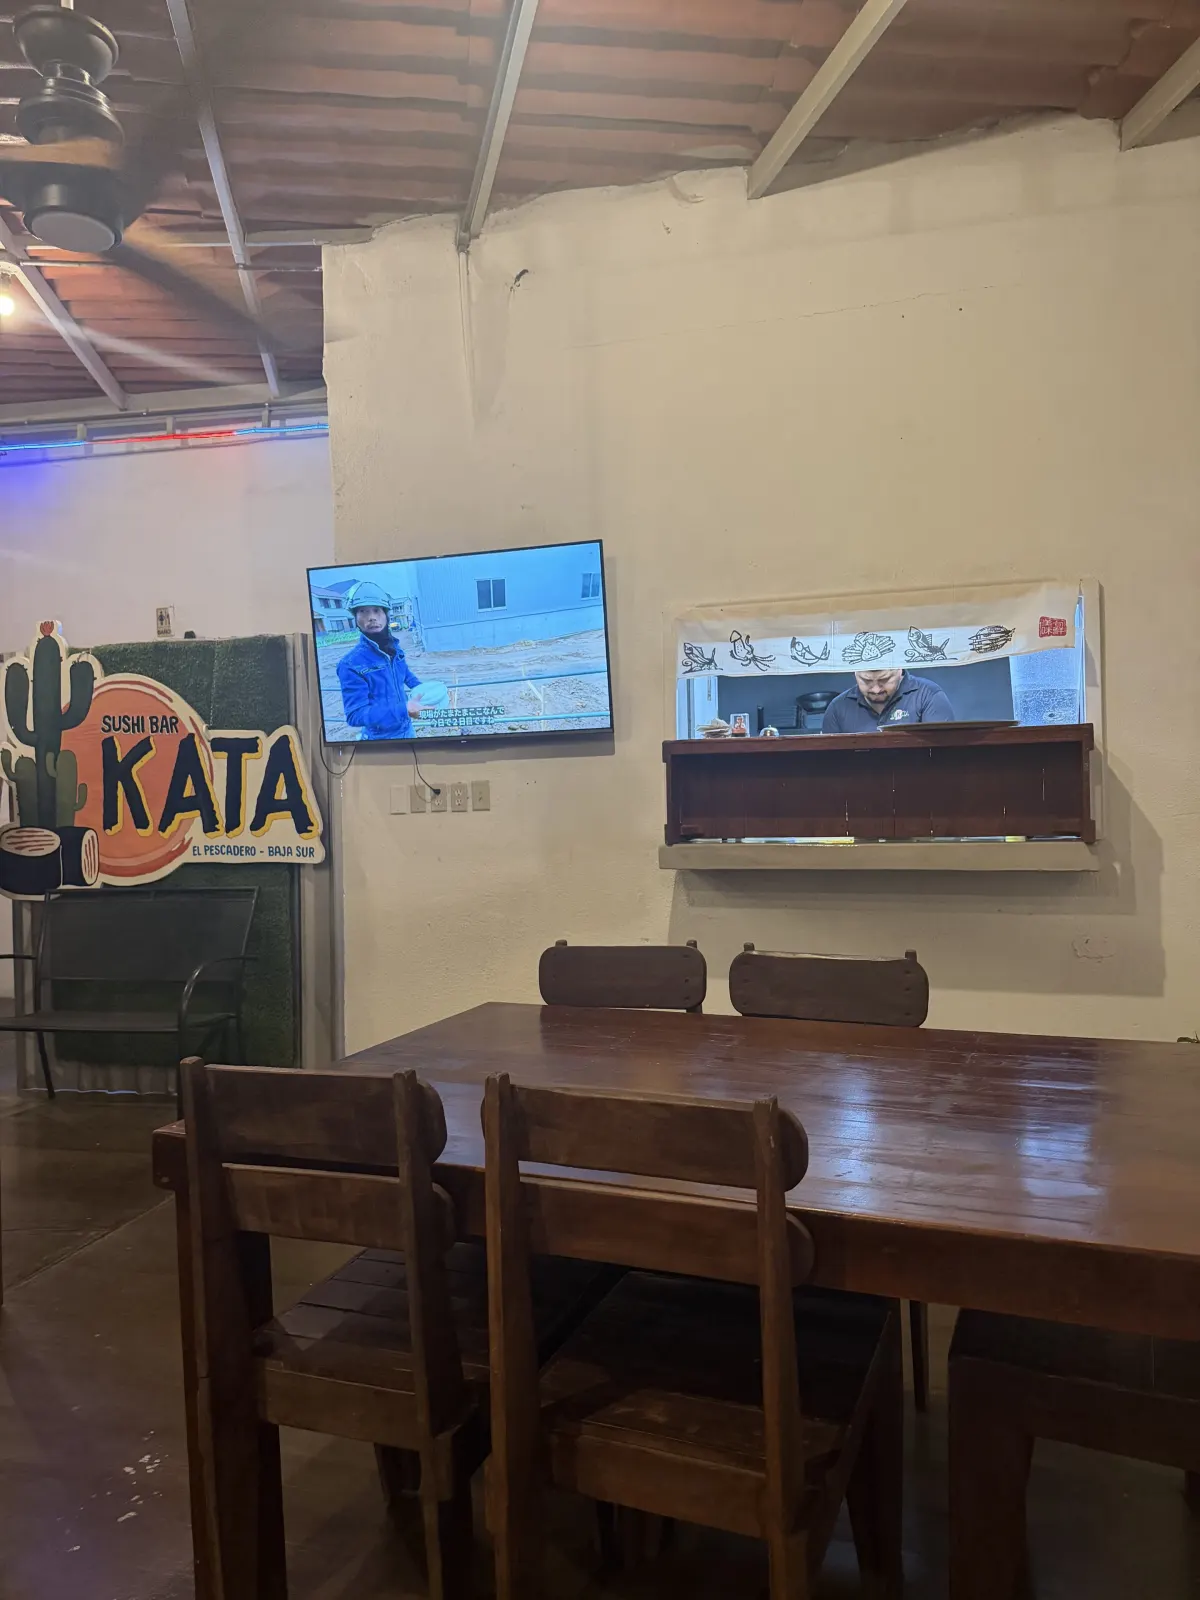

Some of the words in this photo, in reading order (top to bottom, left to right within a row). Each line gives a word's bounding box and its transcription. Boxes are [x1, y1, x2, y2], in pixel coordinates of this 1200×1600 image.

[101, 715, 145, 734] SUSHI
[149, 715, 179, 734] BAR
[101, 733, 320, 839] KATA
[192, 845, 202, 857] EL
[204, 844, 256, 857] PESCADERO
[267, 845, 293, 858] BAJA
[296, 845, 315, 858] SUR
